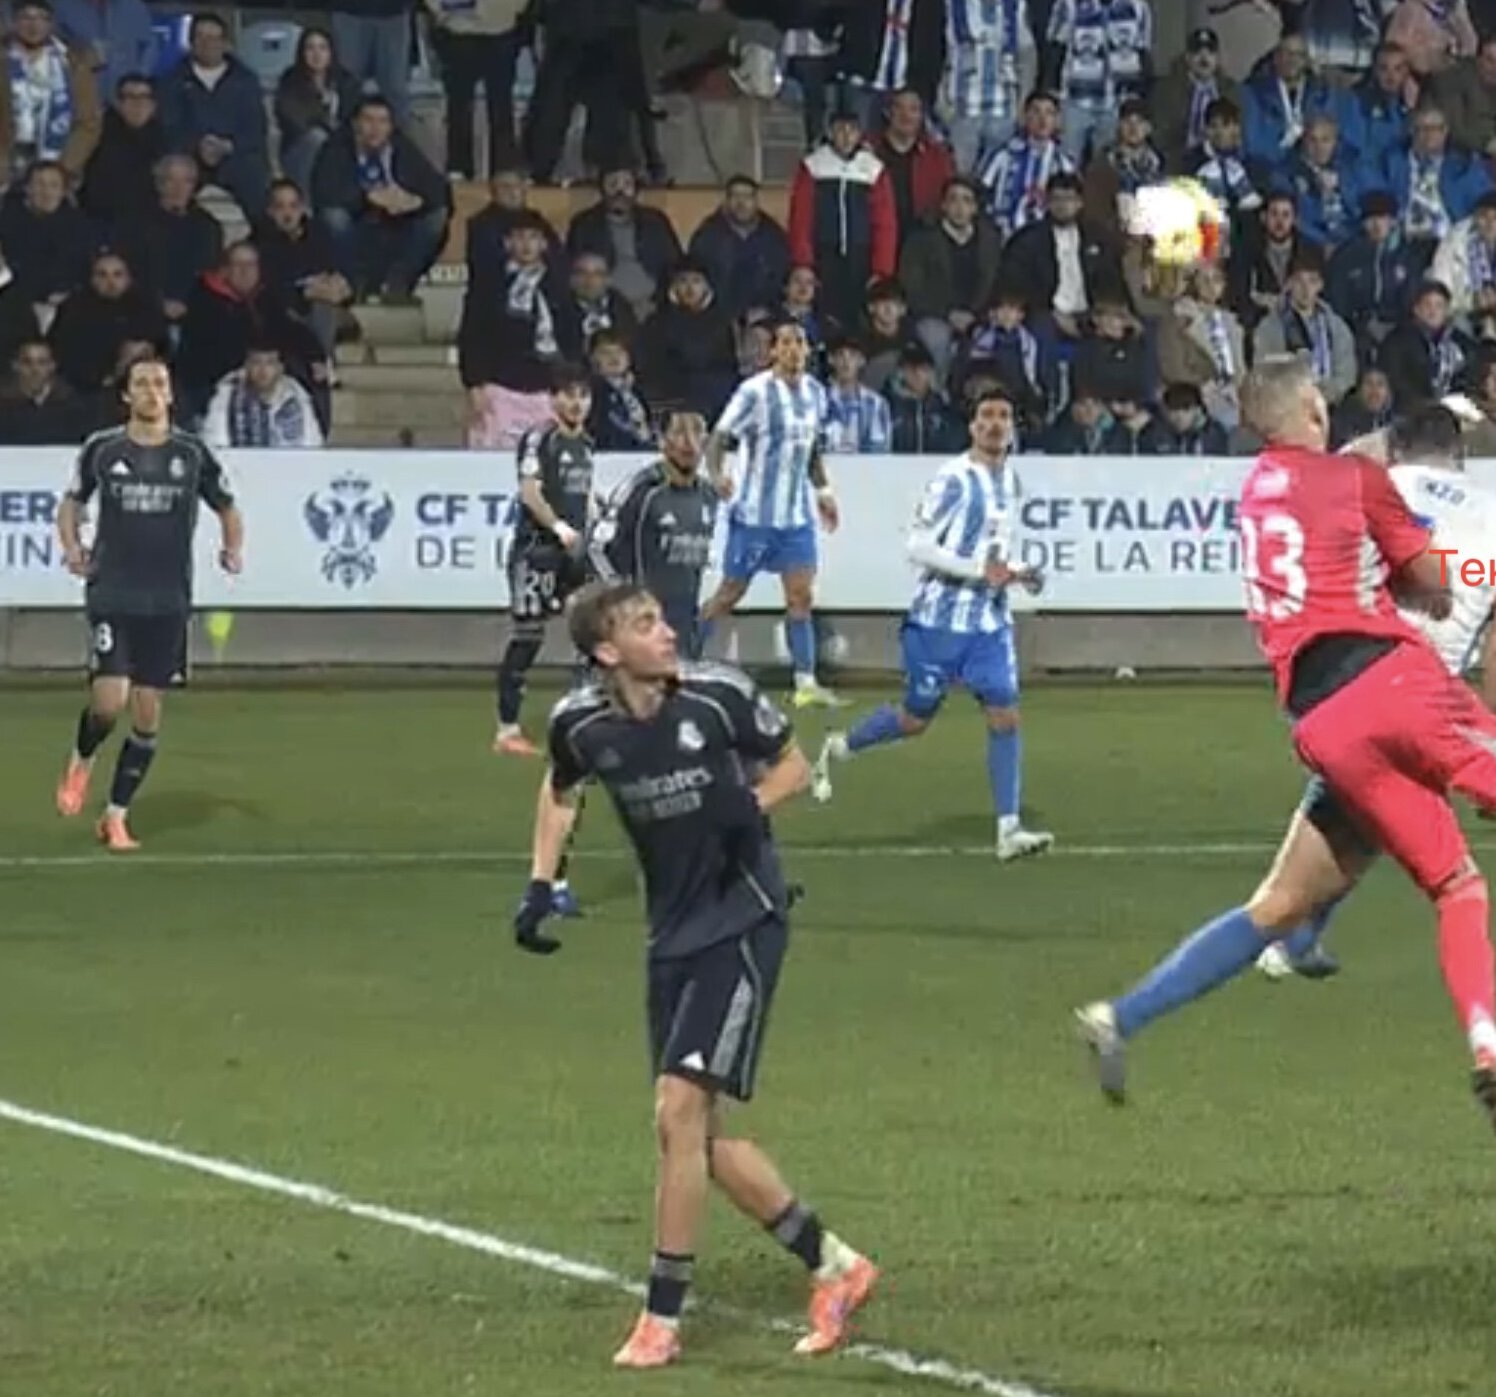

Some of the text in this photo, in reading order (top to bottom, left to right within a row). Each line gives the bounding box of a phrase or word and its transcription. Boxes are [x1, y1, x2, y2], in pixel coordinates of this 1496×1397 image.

[416, 494, 469, 525] CF
[1020, 498, 1070, 529] CF
[417, 536, 475, 568] DE
[1022, 541, 1076, 573] DE
[1096, 541, 1151, 573] LA
